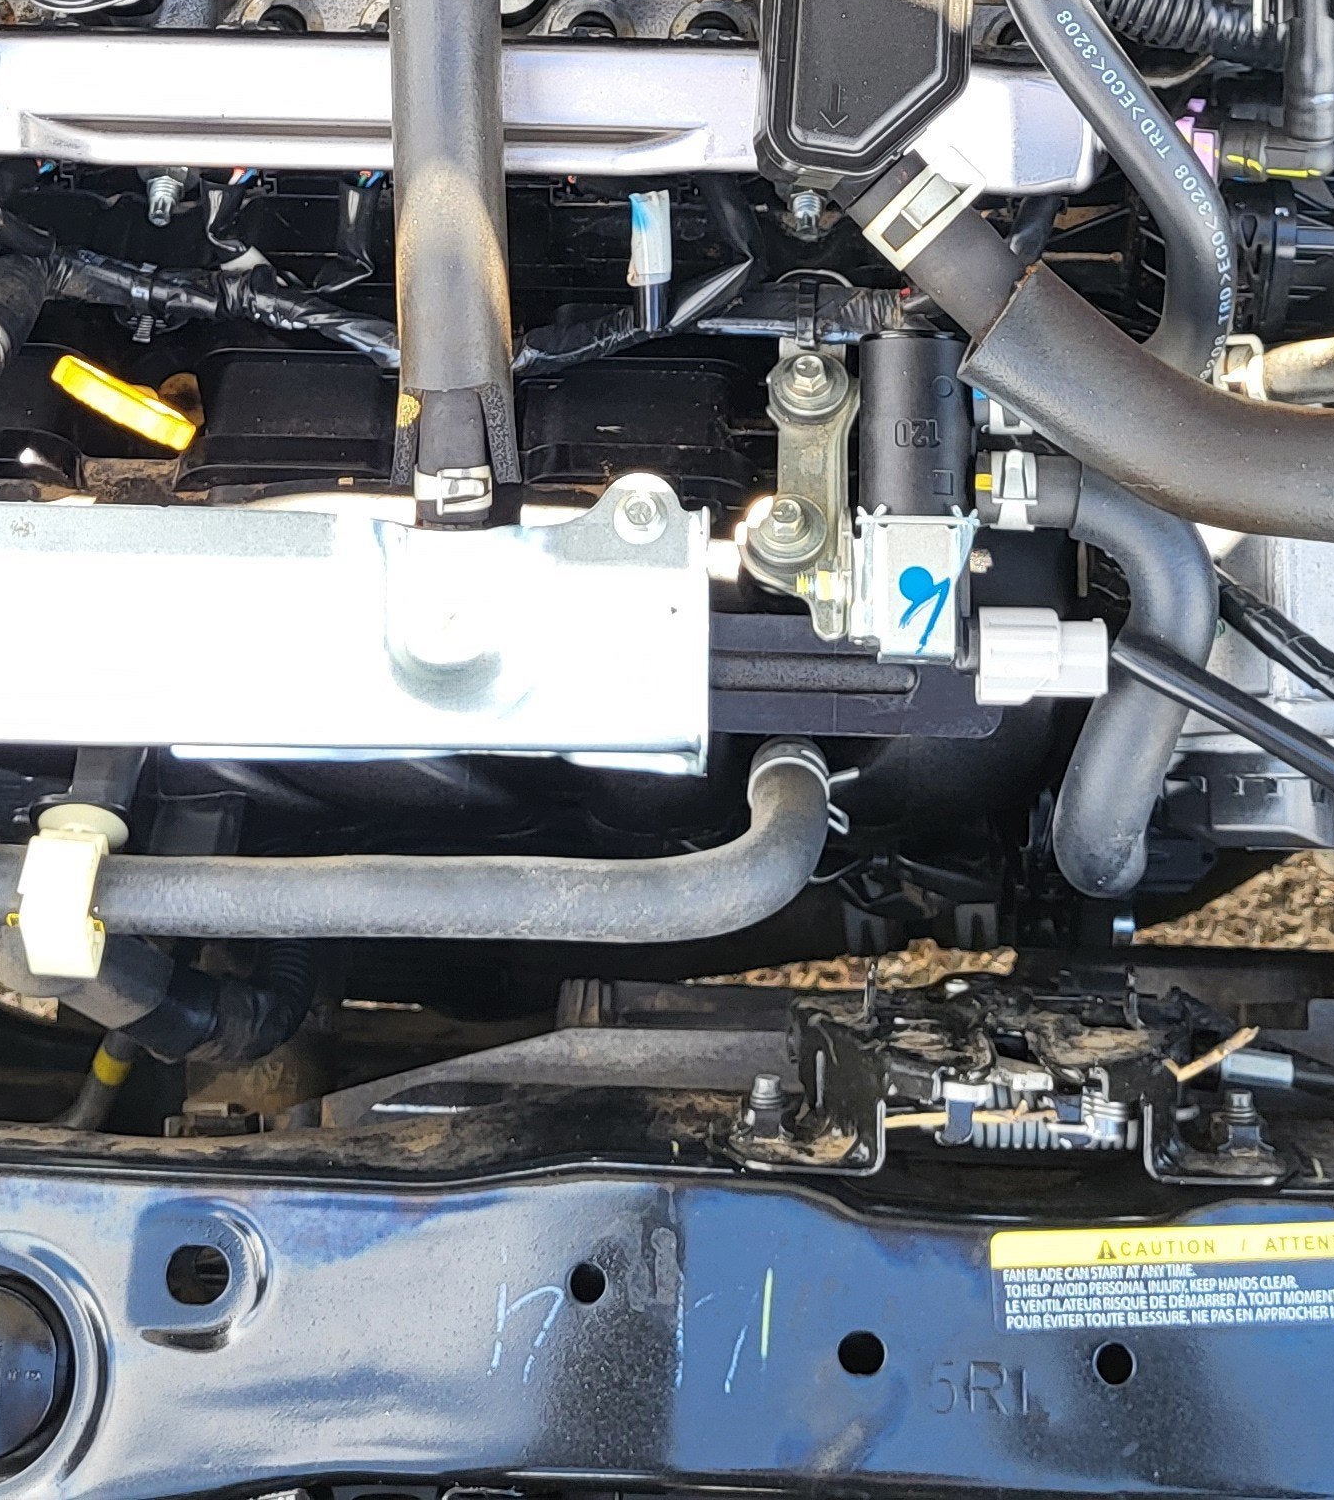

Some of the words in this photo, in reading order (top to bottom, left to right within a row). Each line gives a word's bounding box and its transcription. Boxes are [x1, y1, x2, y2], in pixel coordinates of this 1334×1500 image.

[895, 417, 941, 448] 120
[1121, 1239, 1215, 1257] CAUTION
[1241, 1238, 1246, 1252] /
[1003, 1268, 1026, 1283] FAN
[1027, 1267, 1064, 1282] BLADE
[1065, 1266, 1089, 1281] CAN
[1090, 1265, 1125, 1280] START
[1126, 1265, 1140, 1279] AT
[1141, 1264, 1166, 1278] ANY
[1166, 1263, 1197, 1278] TIME.
[1005, 1284, 1021, 1299] TO
[1023, 1283, 1051, 1298] HELP
[1052, 1282, 1087, 1297] AVOID
[1089, 1280, 1147, 1296] PERSONAL
[1148, 1279, 1189, 1295] INJURY,
[1190, 1278, 1217, 1293] KEEP
[1219, 1276, 1259, 1291] HANDS
[1260, 1275, 1299, 1289] CLEAR.
[1005, 1300, 1019, 1314] LE
[1020, 1297, 1102, 1313] VENTILATEUR
[1103, 1296, 1149, 1312] RISQUE
[1150, 1295, 1167, 1310] DE
[1169, 1292, 1236, 1308] DÉMARRER
[1237, 1290, 1249, 1306] À
[1249, 1290, 1283, 1306] TOUT
[1006, 1314, 1043, 1329] POUR
[1044, 1311, 1085, 1328] ÉVITER
[1085, 1311, 1126, 1327] TOUTE
[1128, 1309, 1191, 1327] BLESSURE,
[1191, 1309, 1210, 1324] NE
[1210, 1308, 1235, 1323] PAS
[1236, 1308, 1253, 1322] EN
[1254, 1305, 1328, 1321] APPROCHER
